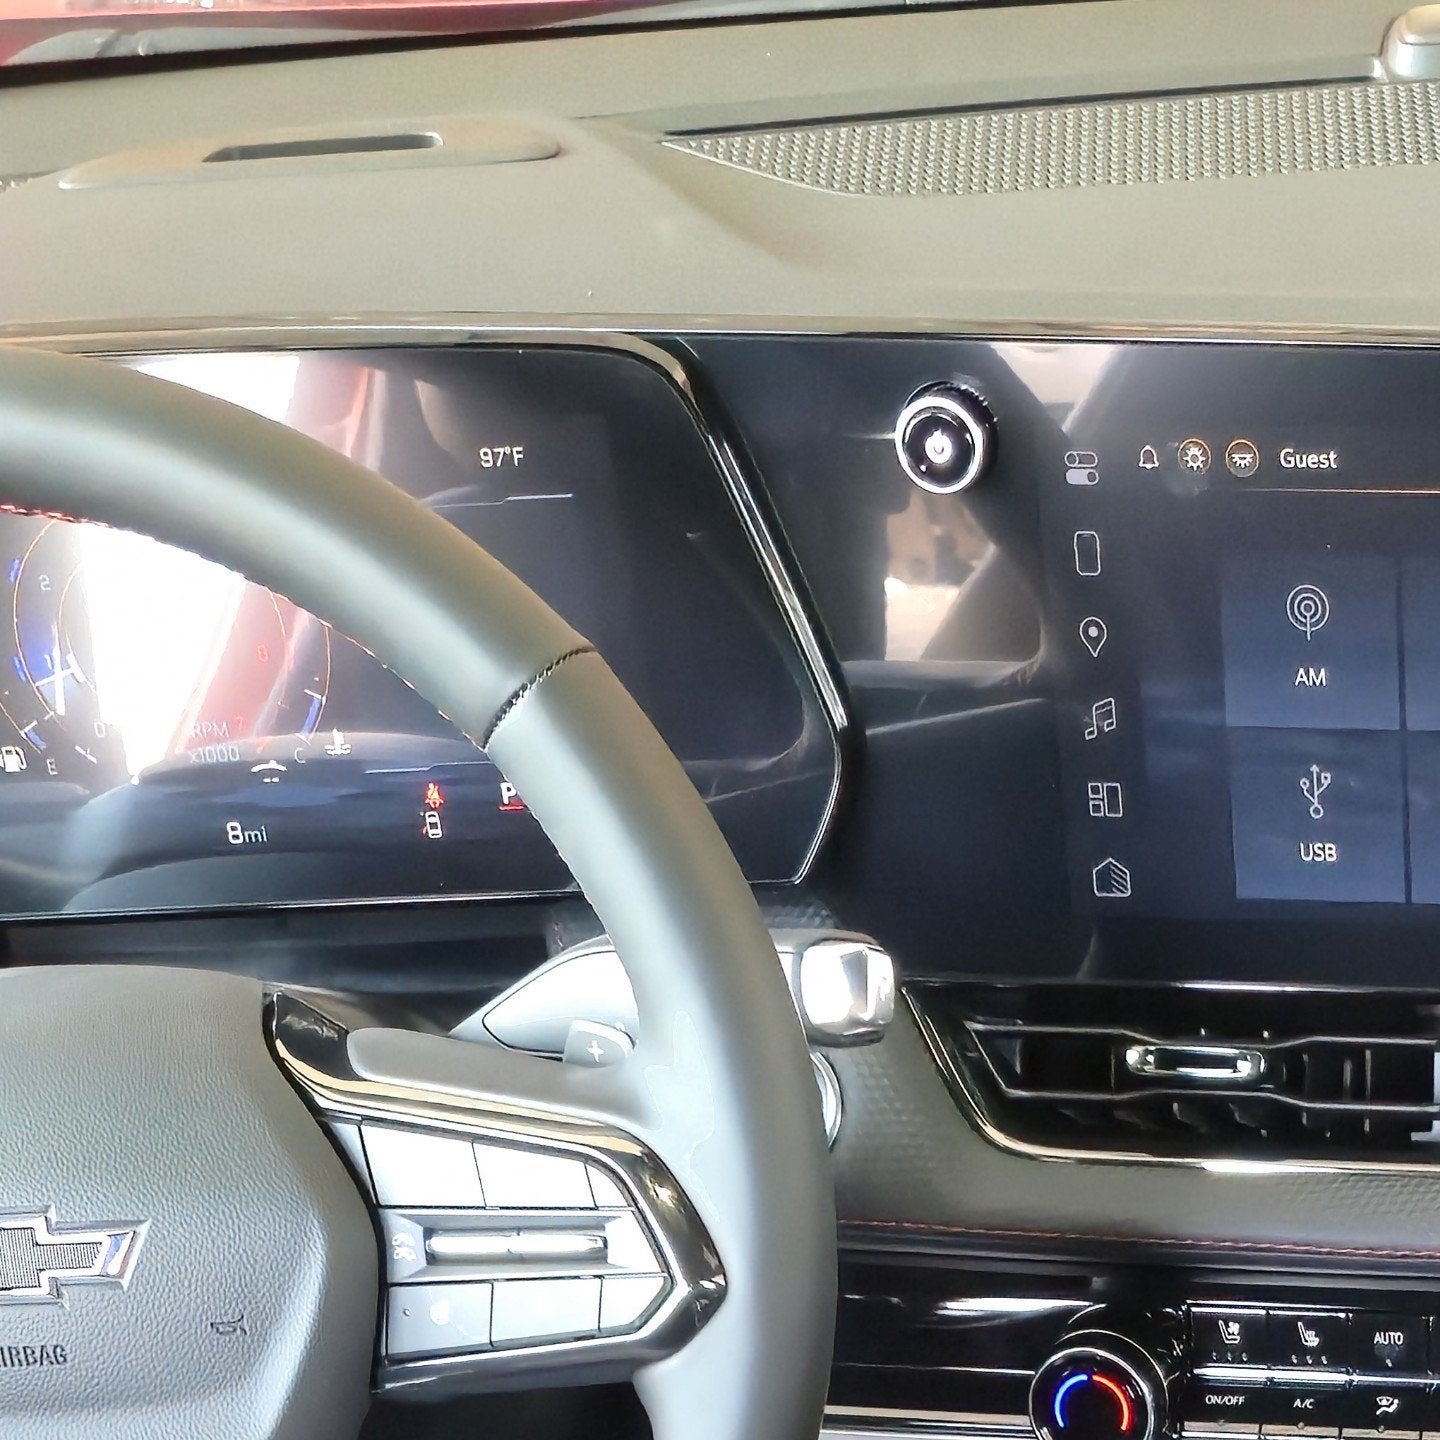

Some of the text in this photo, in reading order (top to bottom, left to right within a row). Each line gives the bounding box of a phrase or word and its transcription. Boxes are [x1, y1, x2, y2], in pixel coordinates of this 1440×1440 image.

[479, 446, 524, 468] 97°F
[1279, 448, 1337, 470] Guest
[1294, 667, 1327, 688] AM
[1299, 842, 1337, 863] USB
[1373, 1330, 1404, 1347] AUTO
[1205, 1394, 1246, 1407] ON/OFF
[1292, 1398, 1315, 1410] A/C
